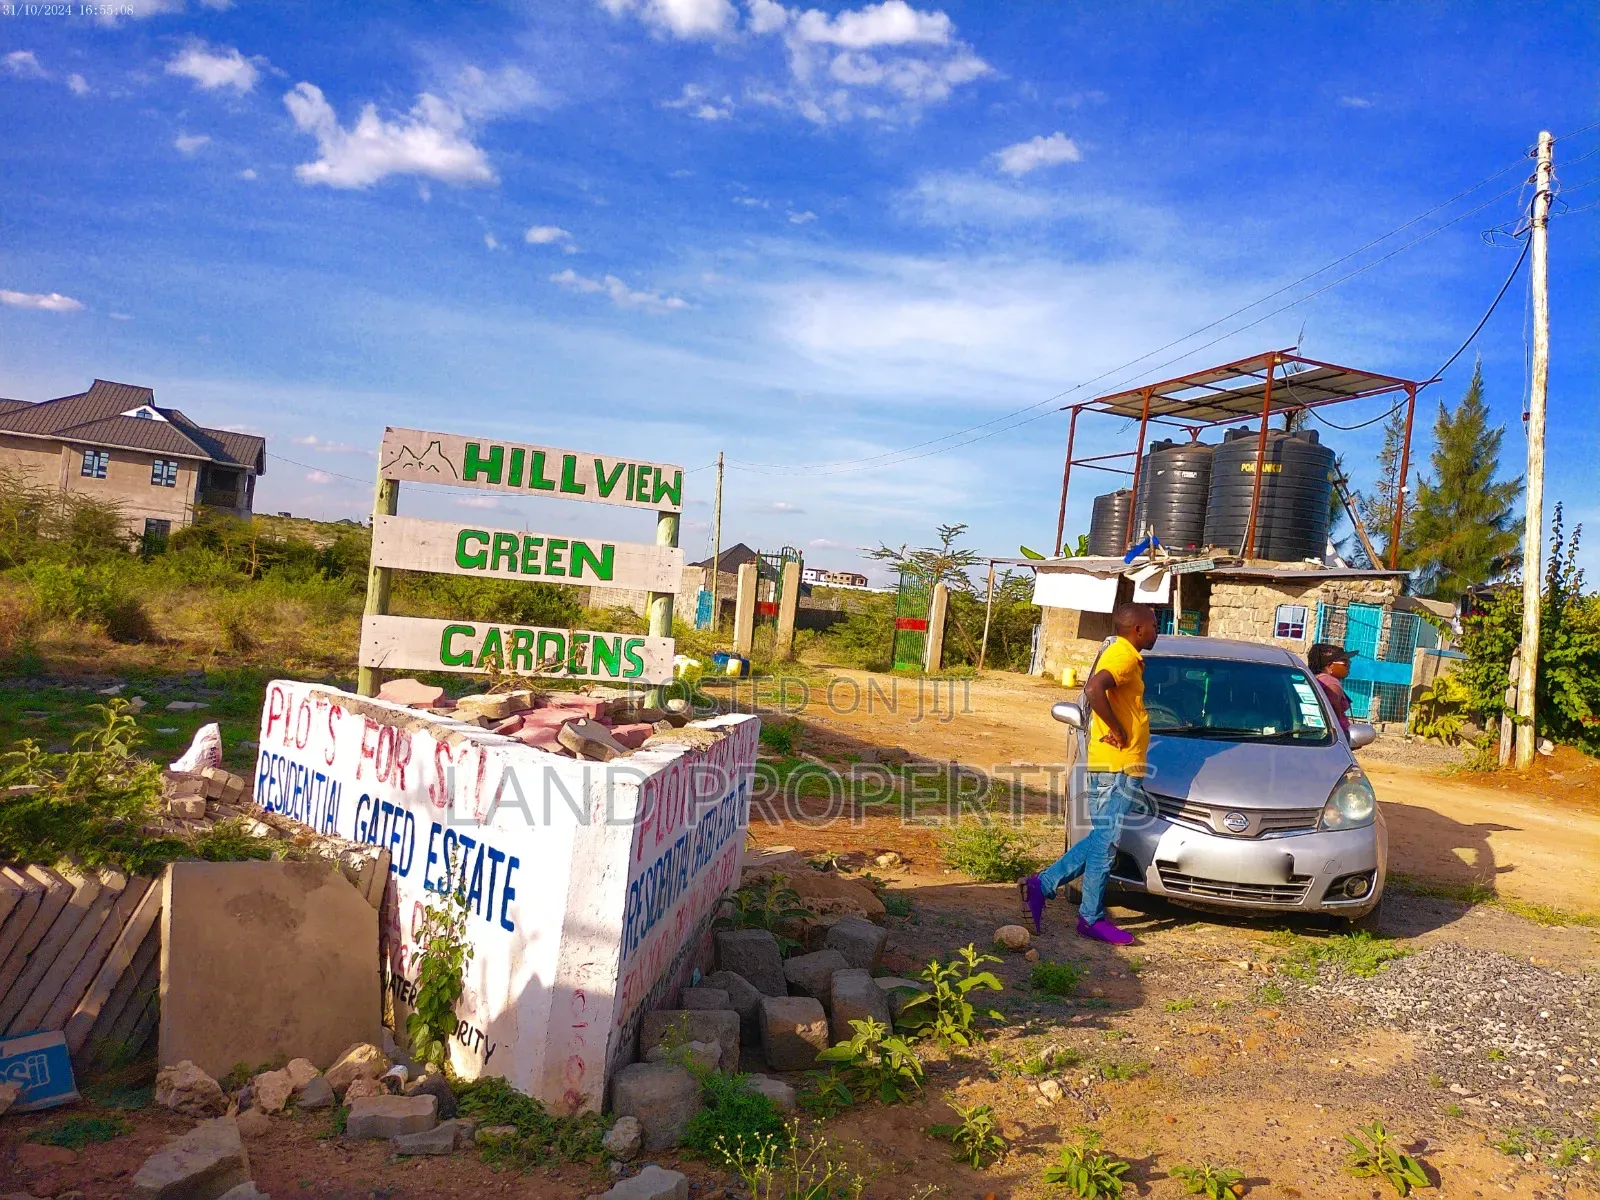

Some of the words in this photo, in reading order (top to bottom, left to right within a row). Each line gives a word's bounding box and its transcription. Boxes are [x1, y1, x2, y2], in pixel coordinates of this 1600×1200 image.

[455, 528, 615, 581] GREEN
[439, 624, 645, 678] GARDENS
[355, 716, 412, 791] FOR
[256, 750, 342, 837] RESIDENTIAL
[354, 793, 416, 878] GATED
[424, 822, 520, 933] ESTATE
[623, 827, 692, 961] RESIDENTIAL
